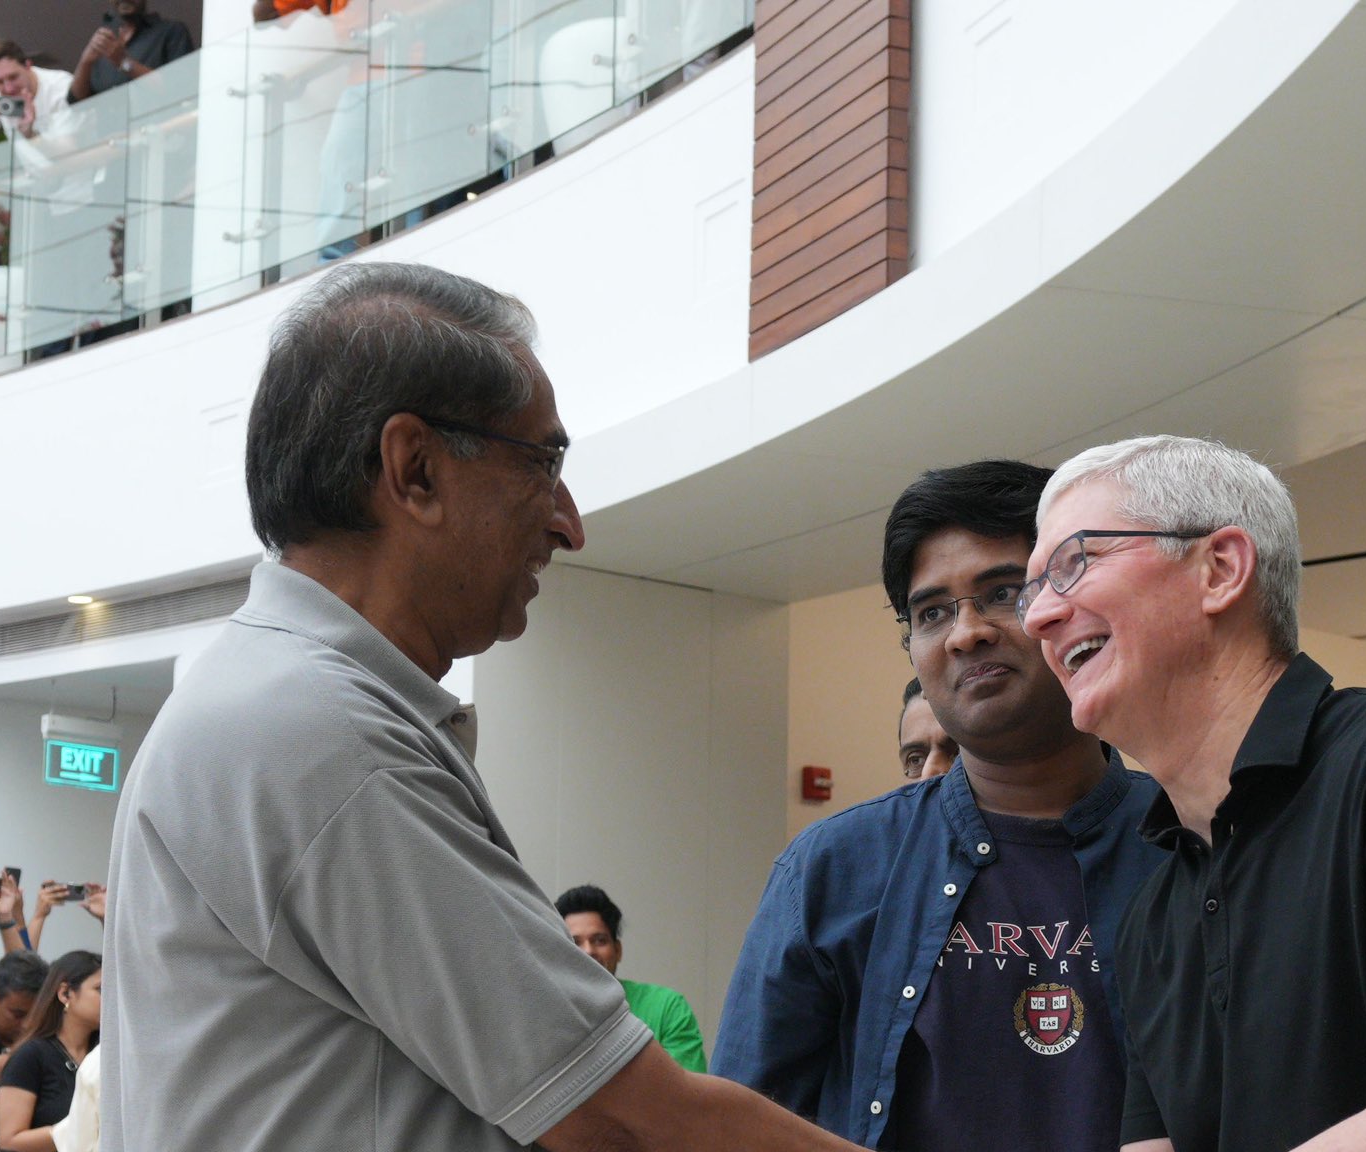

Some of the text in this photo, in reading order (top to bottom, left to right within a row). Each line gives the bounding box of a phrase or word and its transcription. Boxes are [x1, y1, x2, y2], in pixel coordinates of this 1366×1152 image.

[60, 746, 104, 774] EXIT
[944, 920, 1094, 960] ARVA
[1041, 1020, 1056, 1028] TAS
[1027, 1038, 1072, 1054] HARVARD
